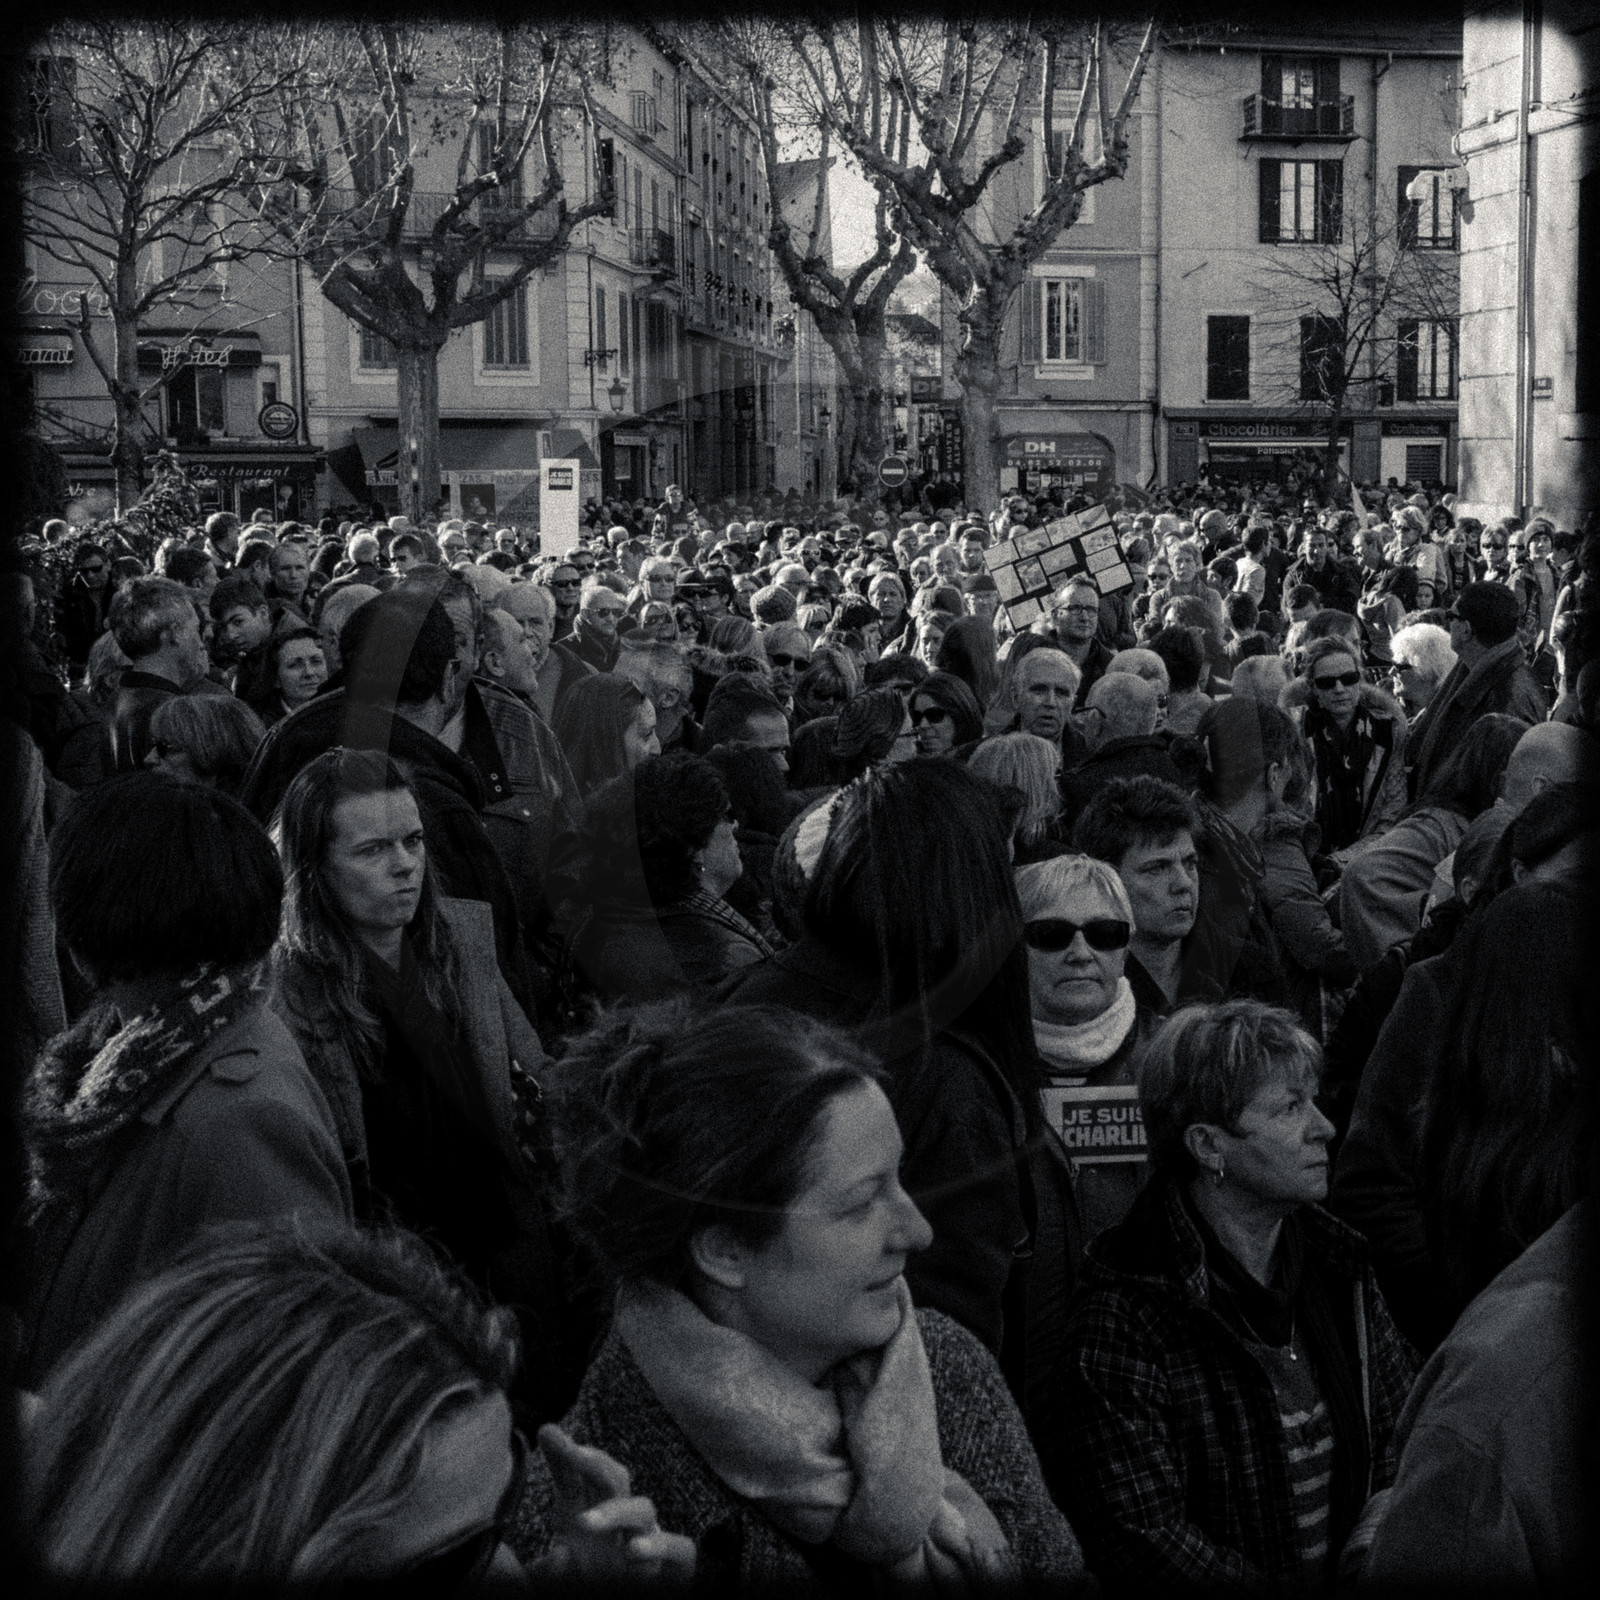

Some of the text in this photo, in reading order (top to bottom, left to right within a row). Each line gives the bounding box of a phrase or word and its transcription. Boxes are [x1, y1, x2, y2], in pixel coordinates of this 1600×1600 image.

[161, 345, 232, 369] Htel
[1208, 423, 1297, 436] Chocolatier
[1024, 441, 1056, 453] DH
[191, 464, 290, 478] Restaurant
[1064, 1108, 1093, 1125] JE
